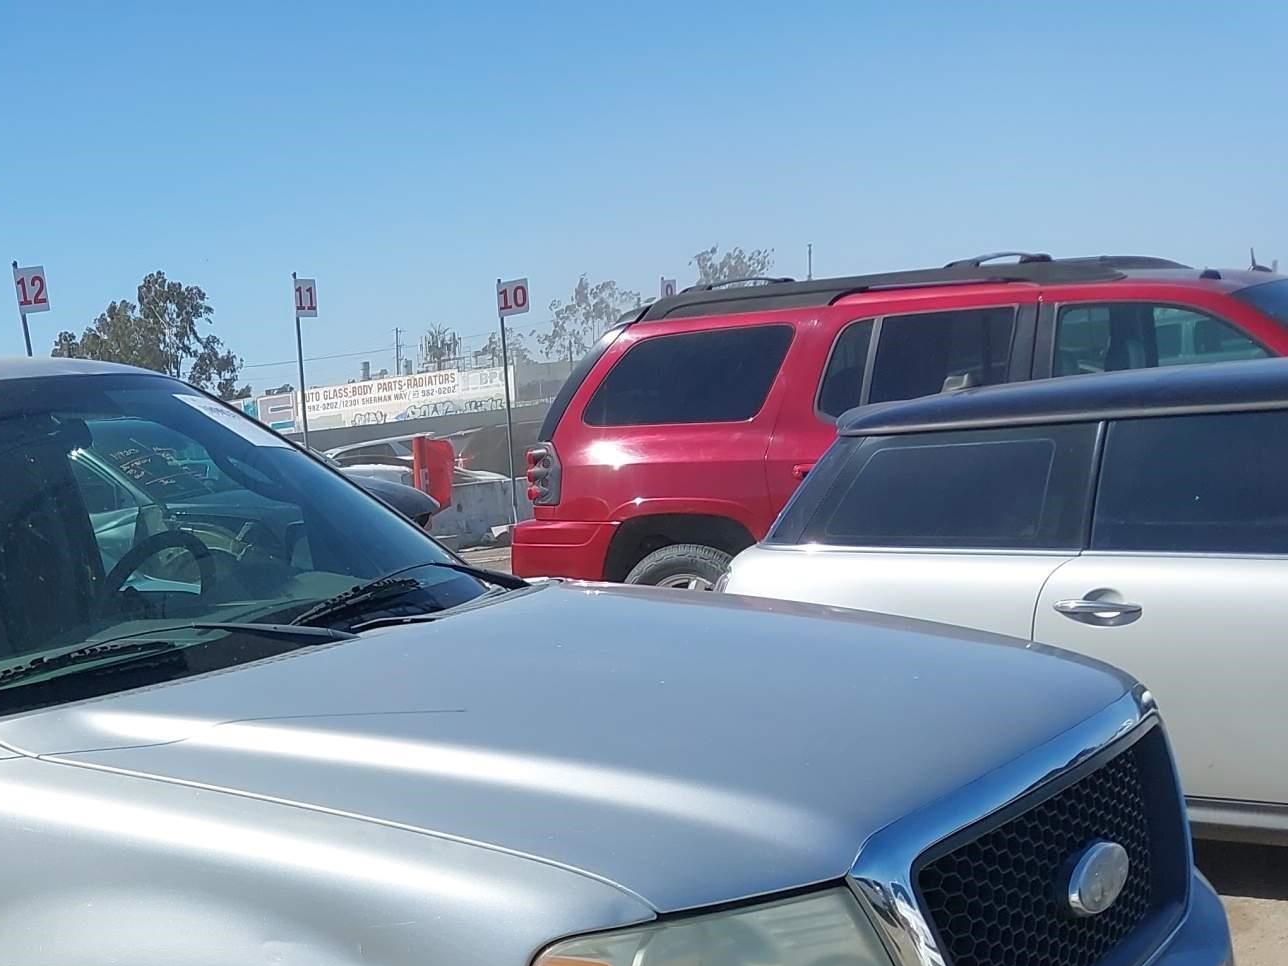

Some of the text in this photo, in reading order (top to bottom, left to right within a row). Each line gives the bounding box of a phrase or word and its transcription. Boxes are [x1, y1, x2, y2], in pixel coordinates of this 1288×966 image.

[16, 275, 47, 306] 12
[295, 286, 317, 311] 11
[498, 285, 527, 310] 10
